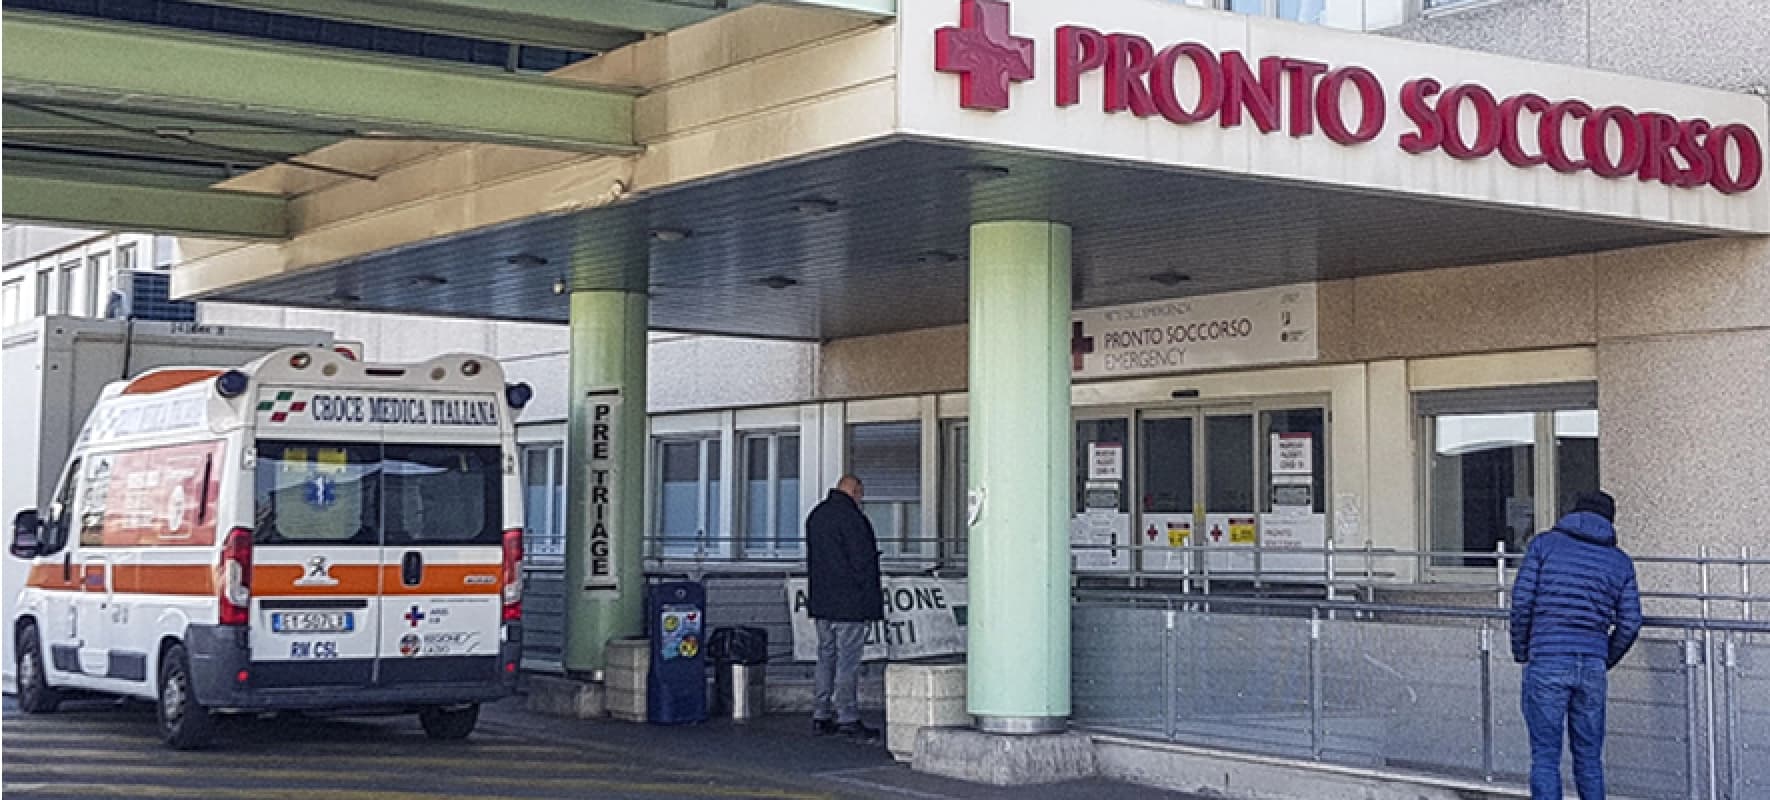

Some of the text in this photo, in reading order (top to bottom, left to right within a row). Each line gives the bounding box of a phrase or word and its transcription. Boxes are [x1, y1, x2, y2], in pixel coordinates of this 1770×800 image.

[1054, 24, 1764, 195] PRONTO SOCCORSO
[1104, 327, 1163, 349] PRONTO
[1167, 317, 1253, 344] SOCCORSO
[1104, 348, 1186, 370] EMERGENCY
[312, 395, 497, 424] CROCE MEDICA ITALIANA
[592, 405, 611, 575] PRE TRIAGE
[291, 641, 338, 658] RM CSL
